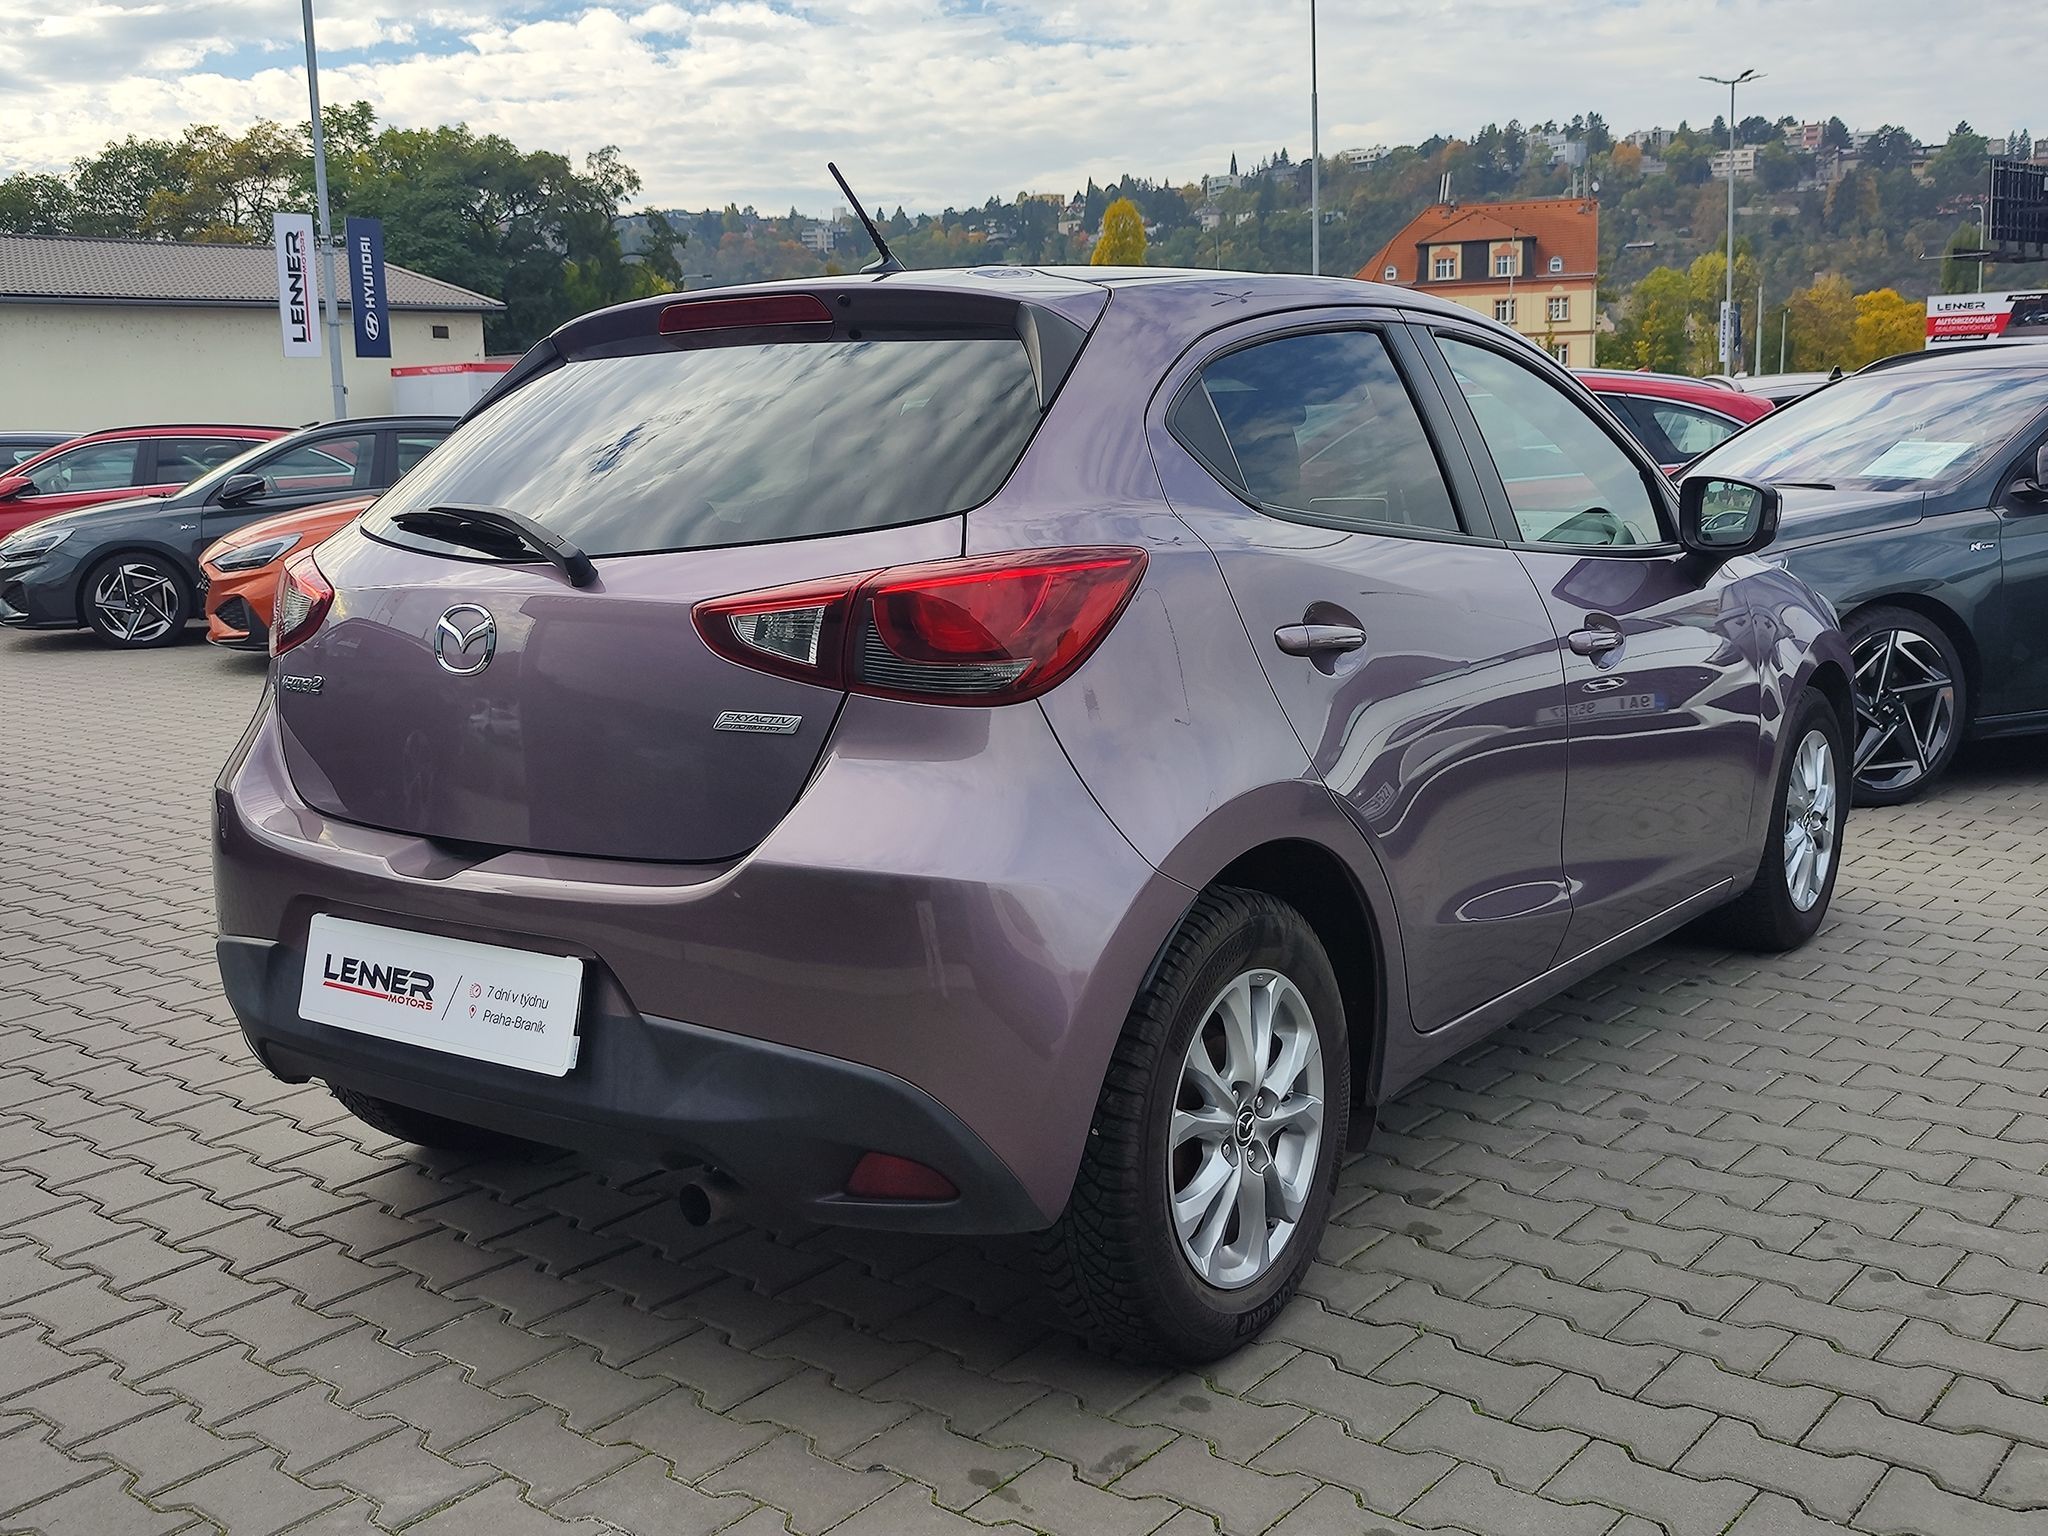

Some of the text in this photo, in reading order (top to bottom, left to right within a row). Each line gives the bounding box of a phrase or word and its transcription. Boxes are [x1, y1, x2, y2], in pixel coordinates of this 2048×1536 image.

[360, 237, 376, 308] HYUNDAI
[286, 231, 308, 343] LENNER
[1937, 302, 1986, 311] LENNER
[725, 713, 793, 724] SKYACTIV
[323, 953, 435, 1001] LENNER
[387, 994, 433, 1011] MOTORS
[487, 985, 549, 1009] 7 dní v týdnu
